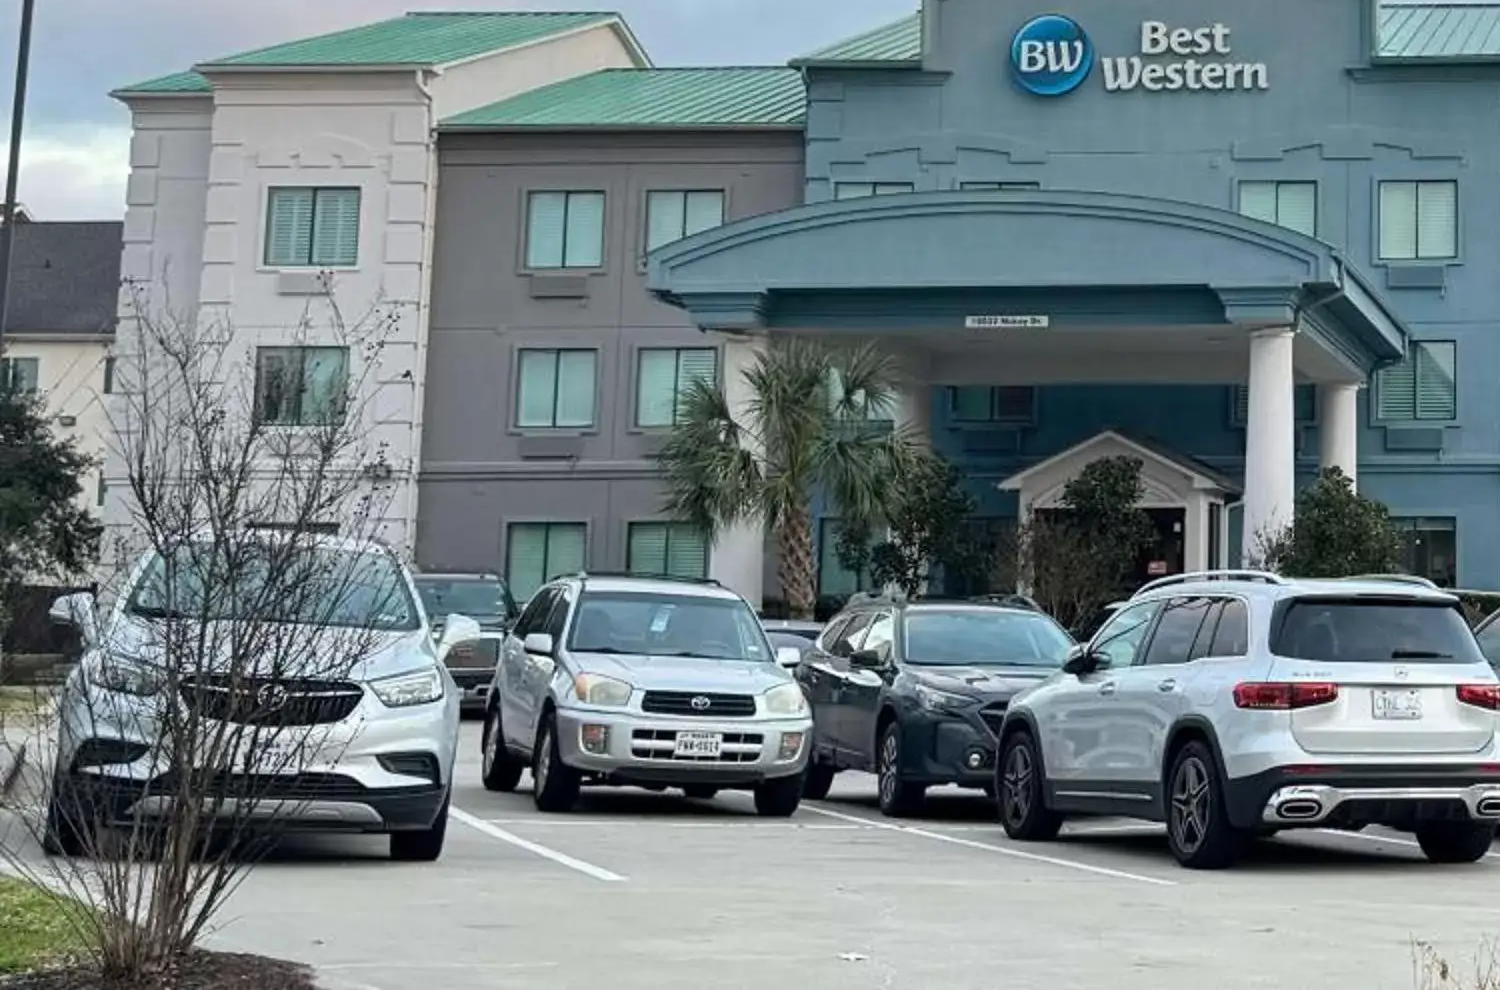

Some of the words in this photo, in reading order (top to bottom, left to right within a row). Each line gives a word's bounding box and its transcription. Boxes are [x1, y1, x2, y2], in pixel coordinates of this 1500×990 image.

[1141, 21, 1231, 54] Best
[1019, 40, 1083, 73] BW
[1102, 56, 1270, 91] Western
